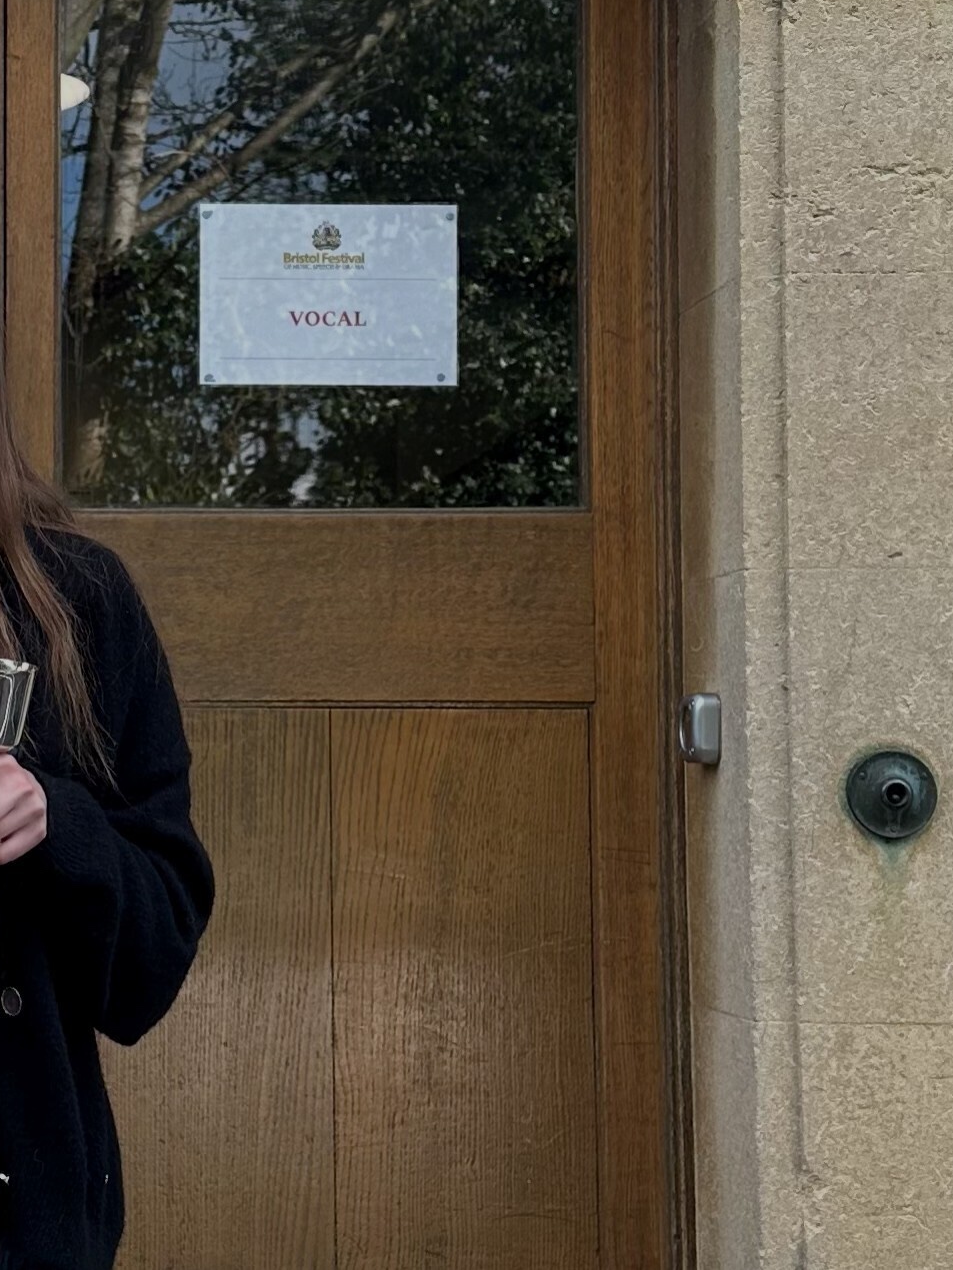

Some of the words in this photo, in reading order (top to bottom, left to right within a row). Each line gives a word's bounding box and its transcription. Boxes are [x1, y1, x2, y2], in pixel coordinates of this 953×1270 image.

[283, 252, 319, 263] Bristol
[322, 252, 365, 263] Festival
[289, 310, 367, 327] VOCAL
